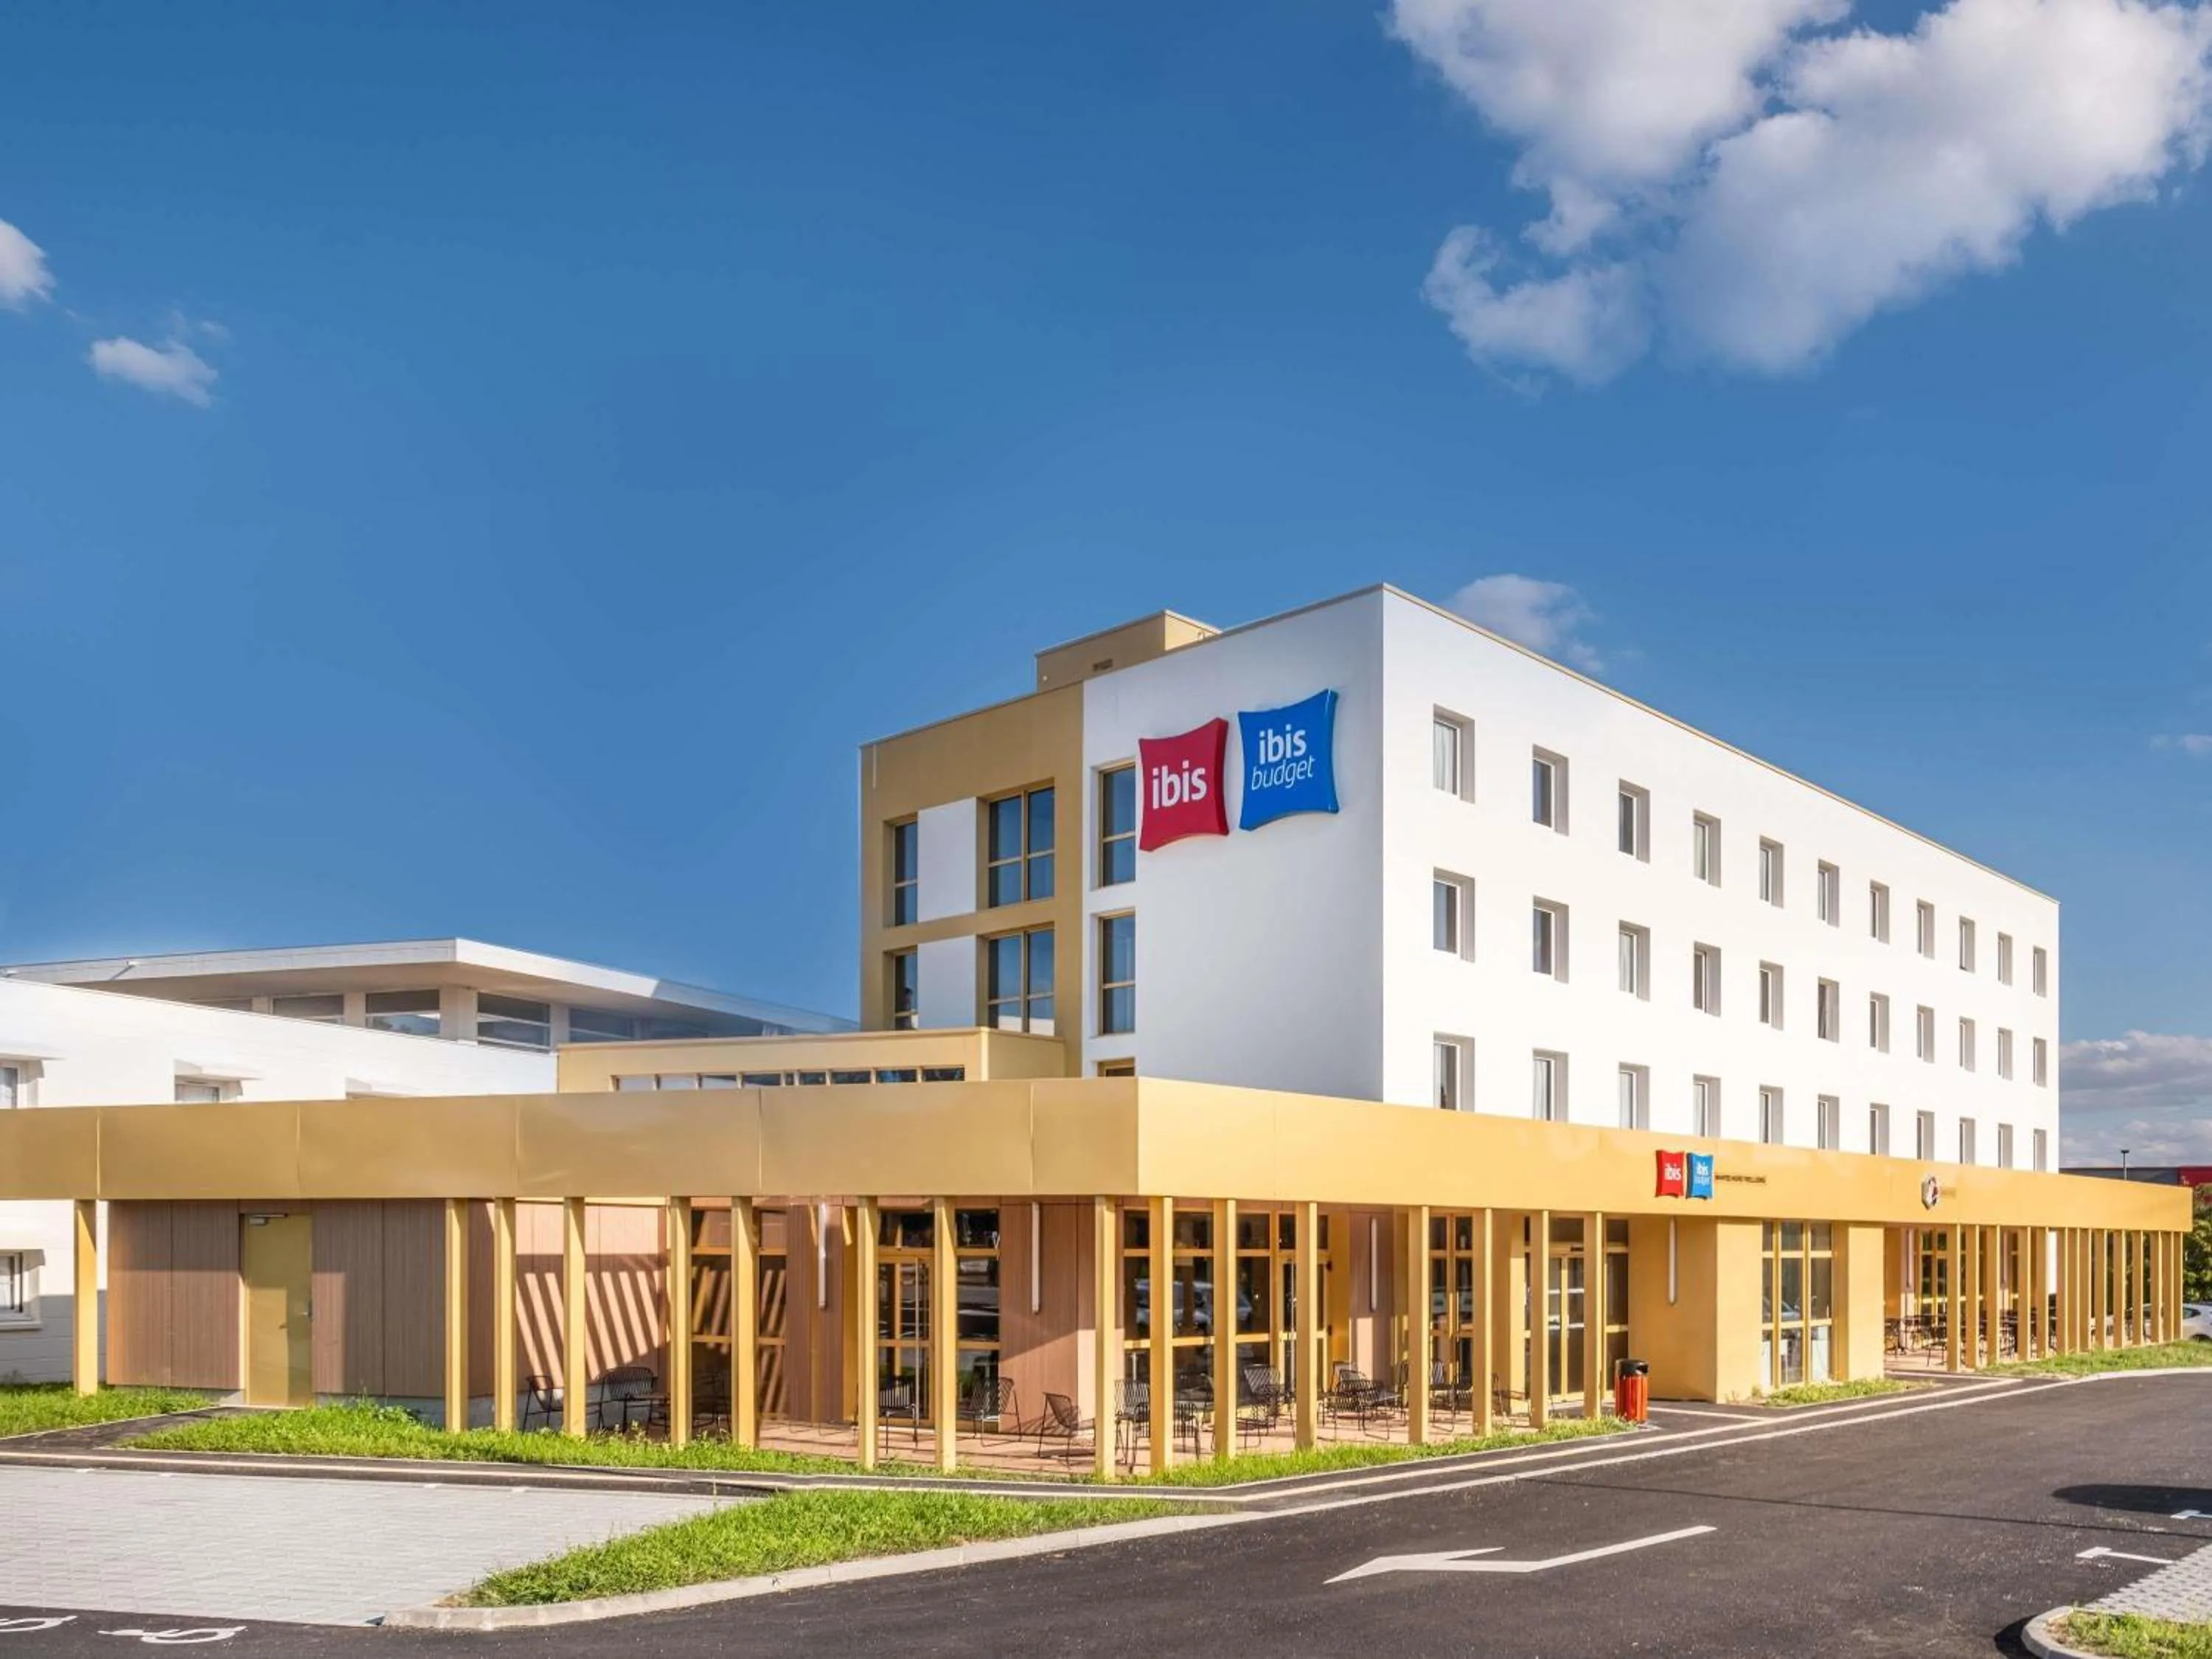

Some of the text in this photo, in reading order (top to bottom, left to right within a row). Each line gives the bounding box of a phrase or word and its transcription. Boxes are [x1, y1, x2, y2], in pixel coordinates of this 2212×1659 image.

[1259, 724, 1307, 765] ibis
[1152, 760, 1207, 810] ibis
[1251, 755, 1315, 790] budget
[1664, 1163, 1682, 1180] ibis
